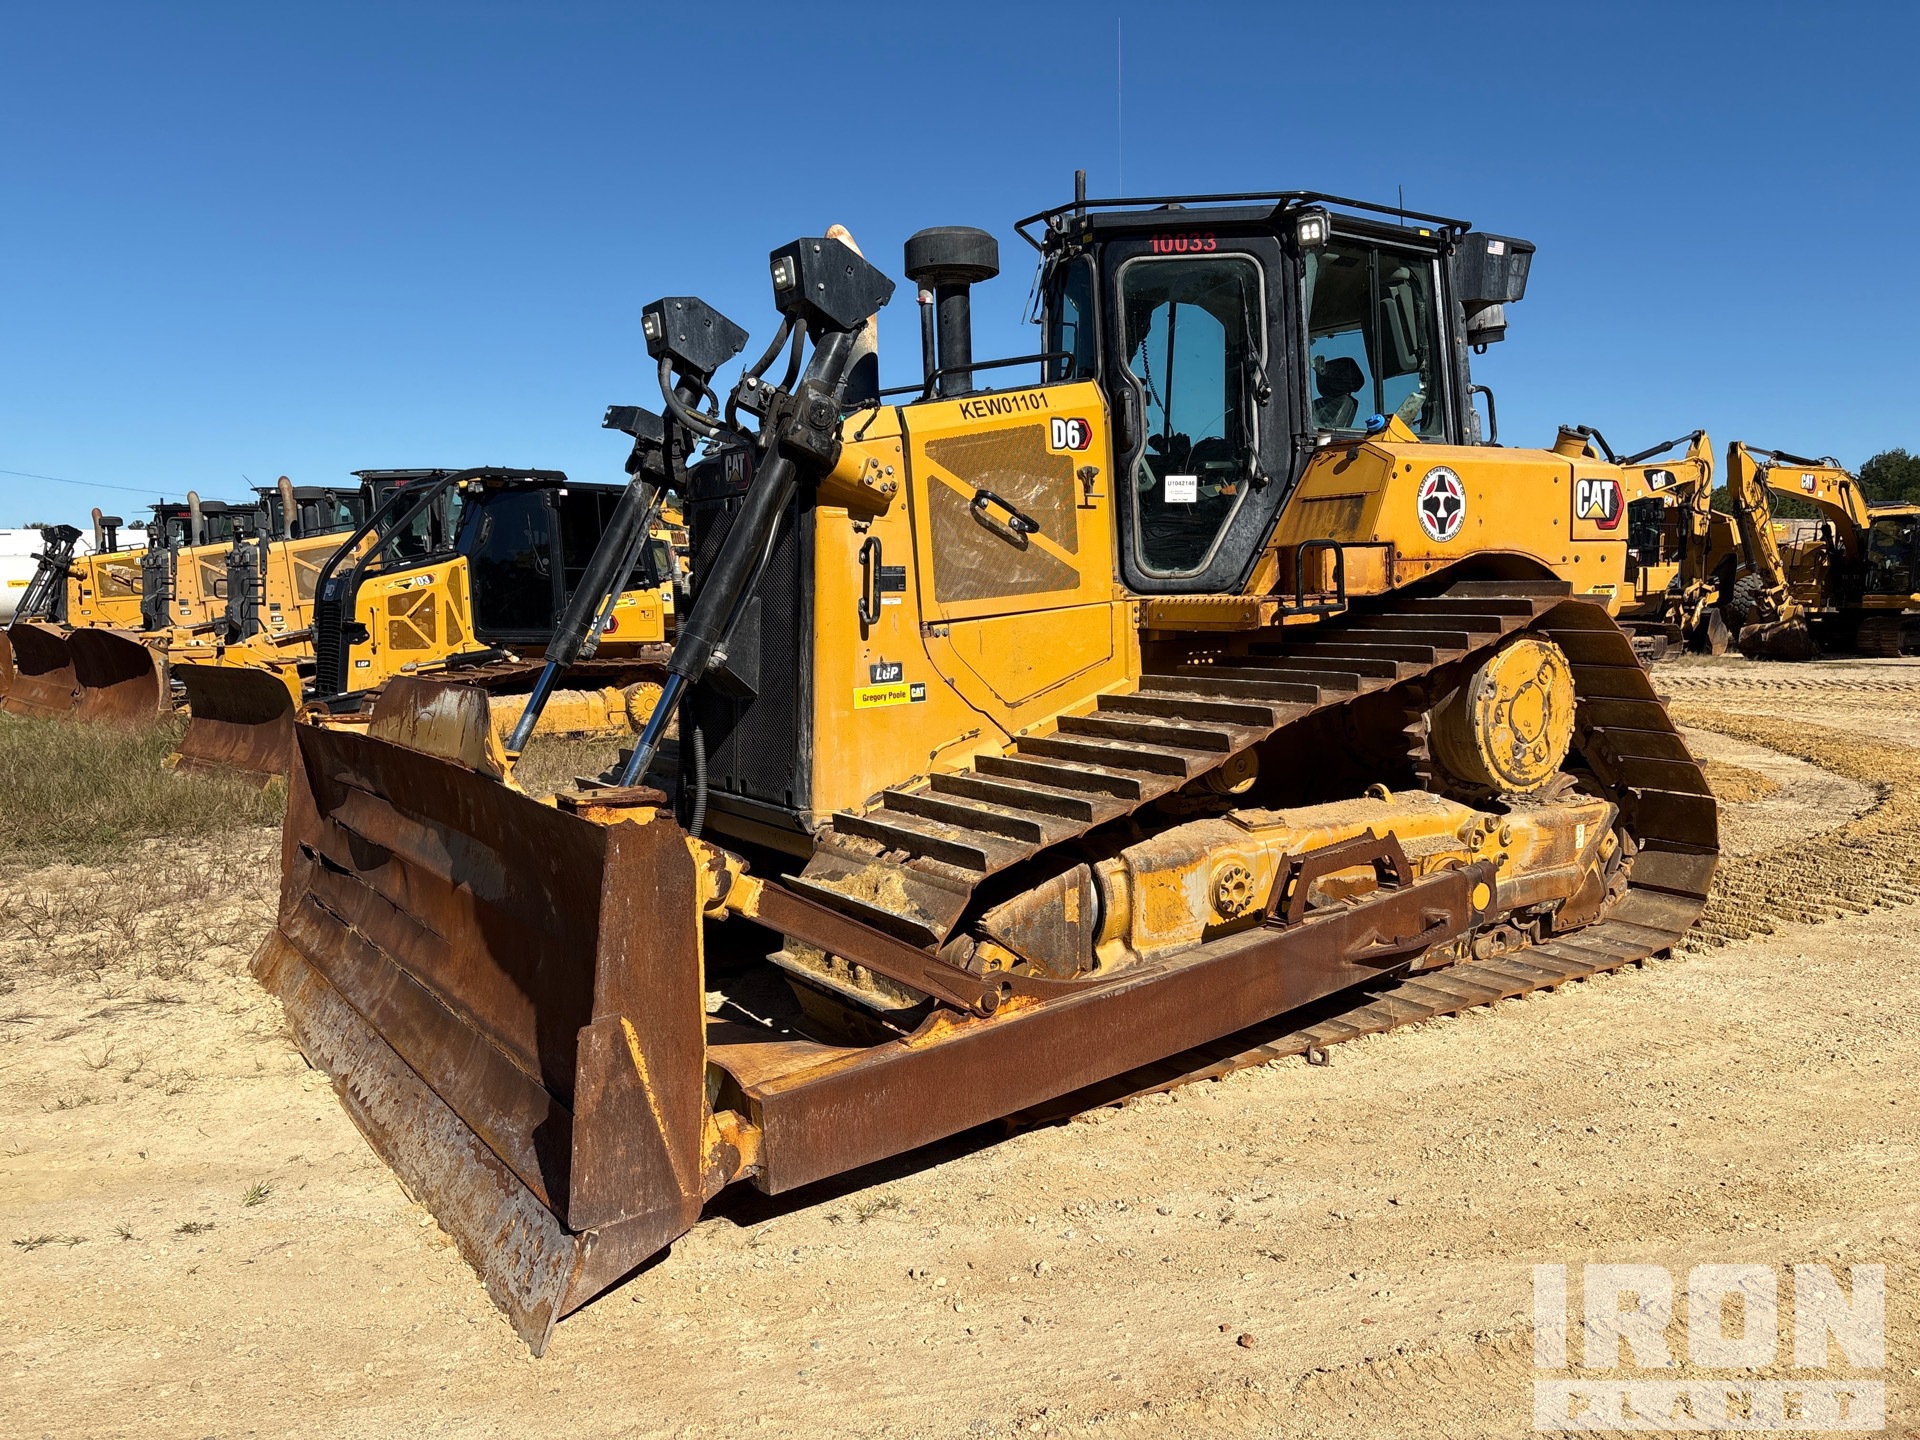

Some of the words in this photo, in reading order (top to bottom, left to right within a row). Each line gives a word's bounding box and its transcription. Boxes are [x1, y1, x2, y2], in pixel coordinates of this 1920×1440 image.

[1149, 232, 1217, 253] 10033
[959, 392, 1049, 420] KEW01101
[1051, 418, 1081, 449] D6
[725, 452, 745, 482] CAT
[1651, 471, 1666, 489] CAT
[1801, 473, 1814, 490] CAT
[1576, 479, 1614, 519] CAT
[1420, 516, 1436, 540] GENERAL
[415, 575, 431, 586] D3
[876, 666, 899, 680] LGP
[862, 693, 887, 703] Gregory
[888, 690, 906, 700] Poole
[911, 687, 925, 698] CAT
